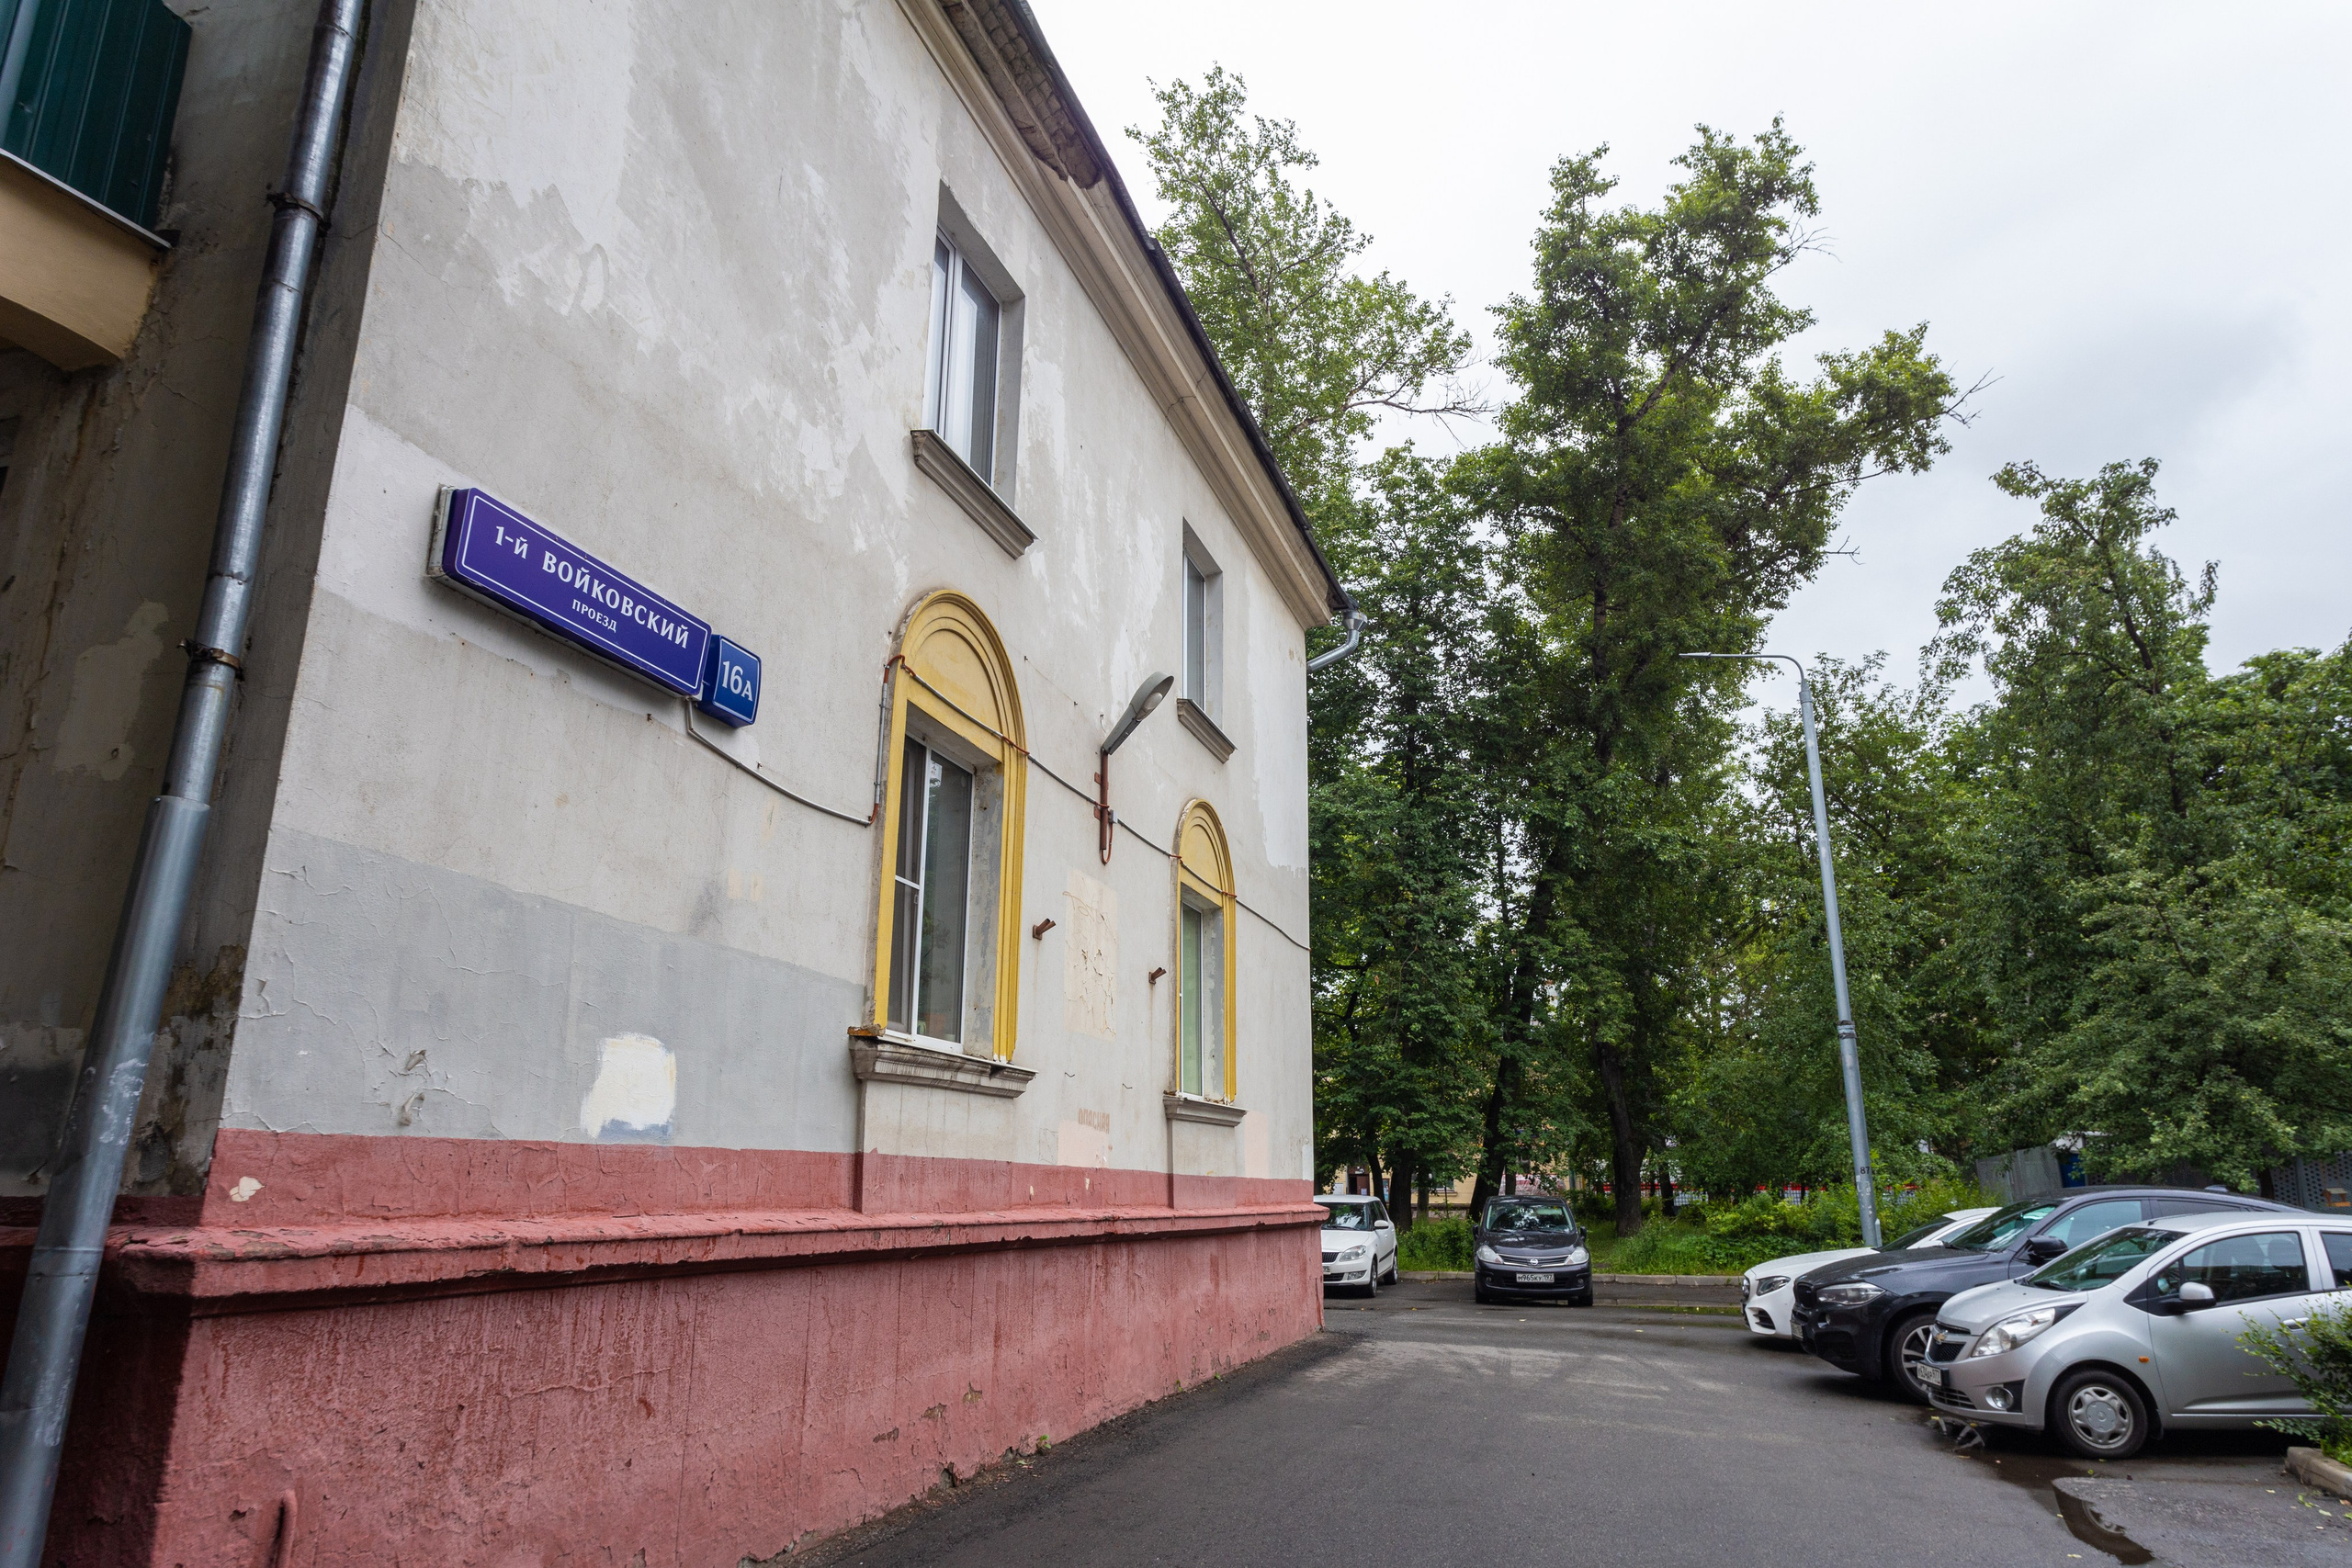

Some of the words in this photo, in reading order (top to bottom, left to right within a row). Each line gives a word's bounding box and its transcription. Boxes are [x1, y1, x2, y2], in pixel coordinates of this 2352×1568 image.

[542, 551, 689, 649] ВОЙКОВСКИЙ
[571, 599, 617, 633] ПРОЕЗД
[721, 660, 753, 702] 16А
[1860, 1166, 1871, 1175] 87
